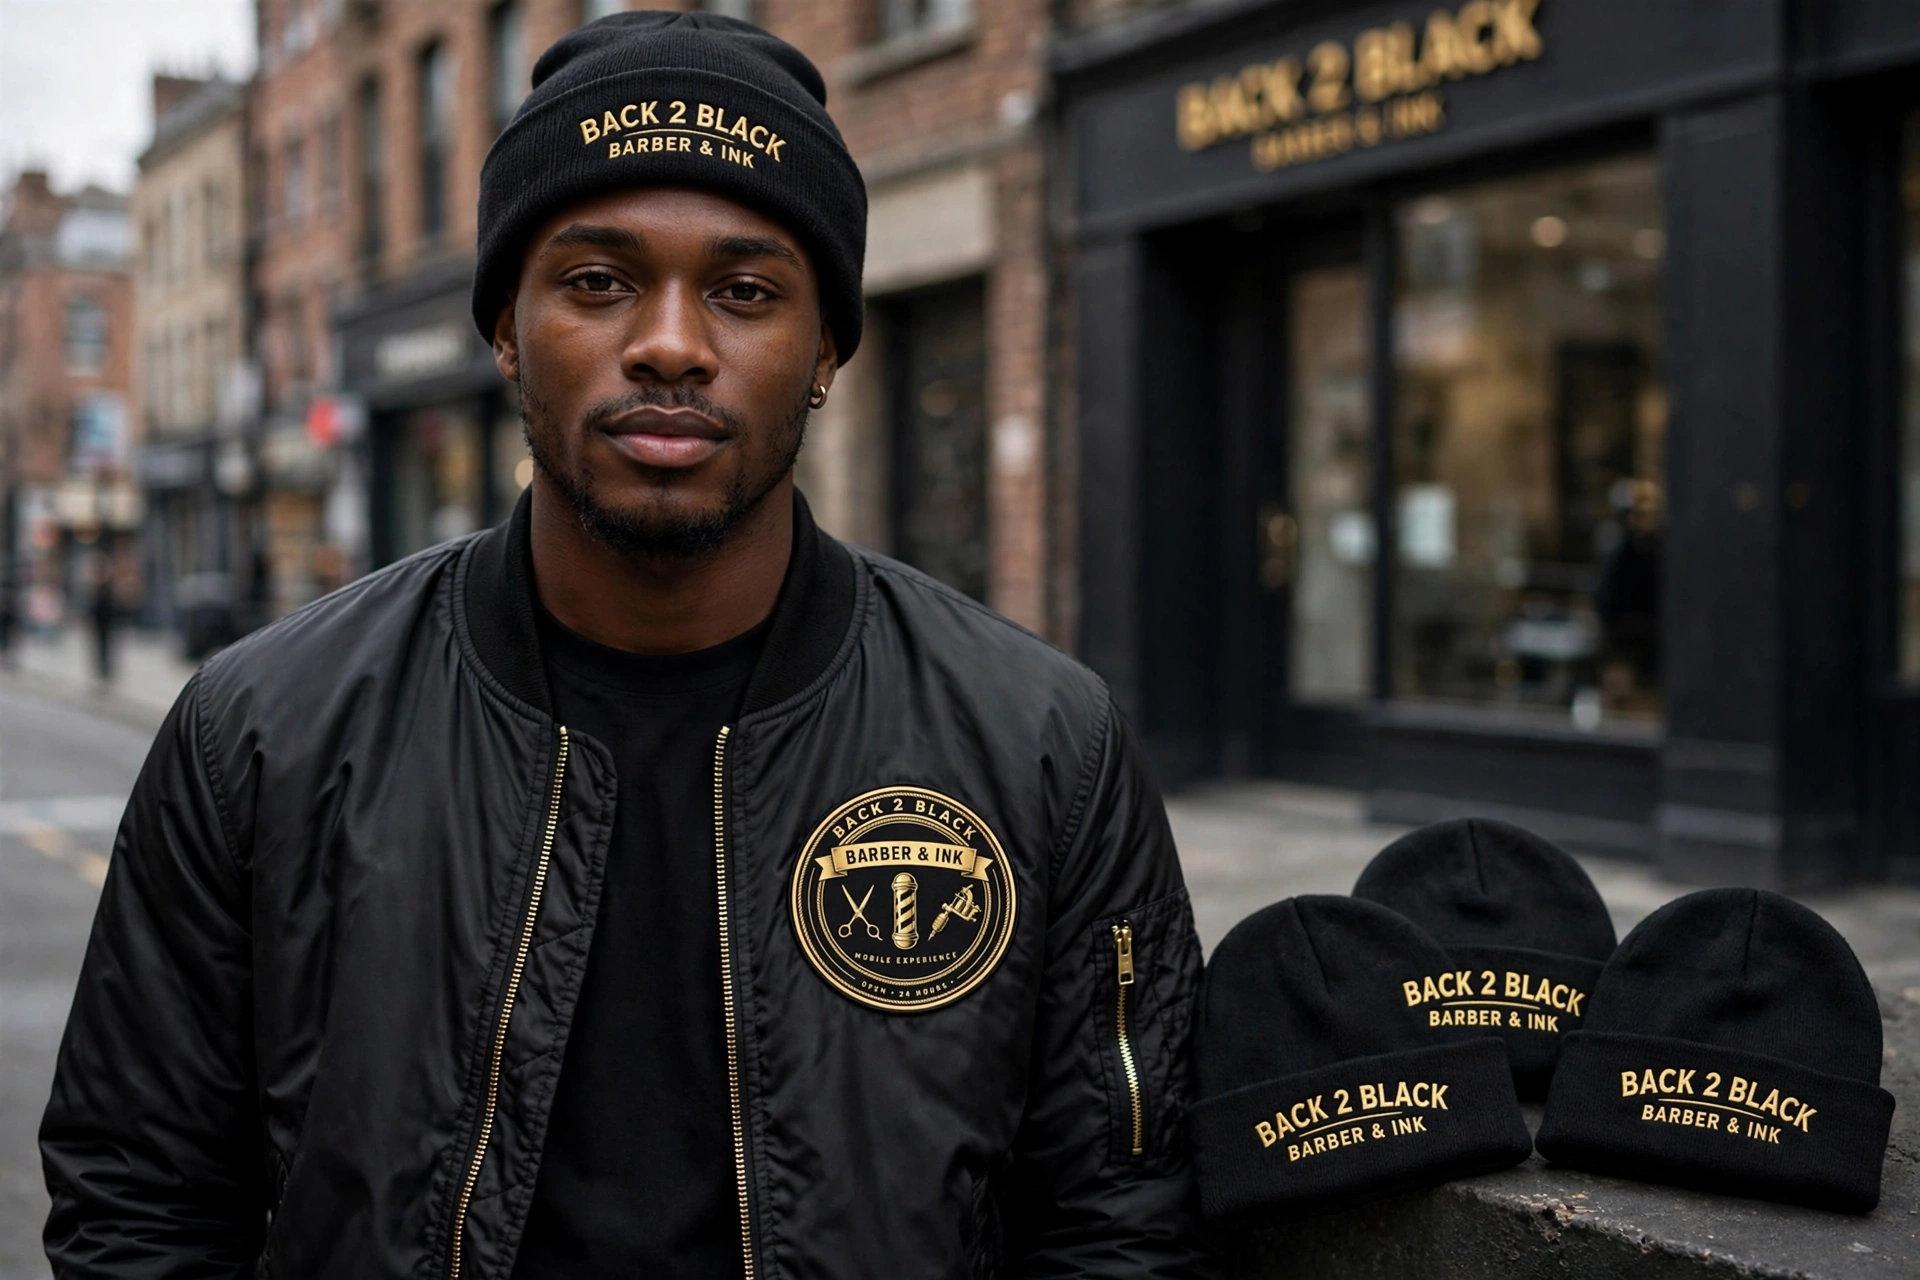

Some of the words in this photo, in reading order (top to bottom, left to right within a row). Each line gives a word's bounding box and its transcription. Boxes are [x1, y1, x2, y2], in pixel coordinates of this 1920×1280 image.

[1307, 40, 1350, 112] 2
[1354, 0, 1543, 101] BLACK
[580, 100, 660, 145] BACK
[669, 101, 686, 124] 2
[697, 103, 787, 162] BLACK
[608, 137, 691, 159] BARBER
[700, 140, 713, 156] &
[721, 145, 755, 169] INK
[832, 802, 884, 839] BACK
[893, 798, 903, 812] 2
[915, 800, 977, 841] BLACK
[845, 846, 911, 865] BARBER
[917, 847, 929, 861] &
[935, 847, 963, 865] INK
[854, 952, 891, 964] MOBILE
[896, 951, 957, 965] EXPERIENCE
[861, 980, 887, 994] OPEN
[898, 990, 911, 998] 24
[916, 982, 948, 997] HOURS
[1402, 970, 1474, 1007] BACK
[1480, 970, 1496, 996] 2
[1504, 971, 1586, 1017] BLACK
[1429, 1009, 1502, 1027] BARBER
[1508, 1011, 1522, 1028] &
[1528, 1013, 1559, 1033] INK
[1255, 1095, 1330, 1148] BACK
[1333, 1089, 1353, 1115] 2
[1359, 1081, 1449, 1110] BLACK
[1621, 1068, 1697, 1097] BACK
[1702, 1072, 1722, 1098] 2
[1728, 1076, 1818, 1133] BLACK
[1287, 1127, 1365, 1162] BARBER
[1371, 1123, 1386, 1139] &
[1391, 1116, 1427, 1136] INK
[1641, 1104, 1720, 1130] BARBER
[1726, 1117, 1740, 1134] &
[1747, 1121, 1782, 1144] INK
